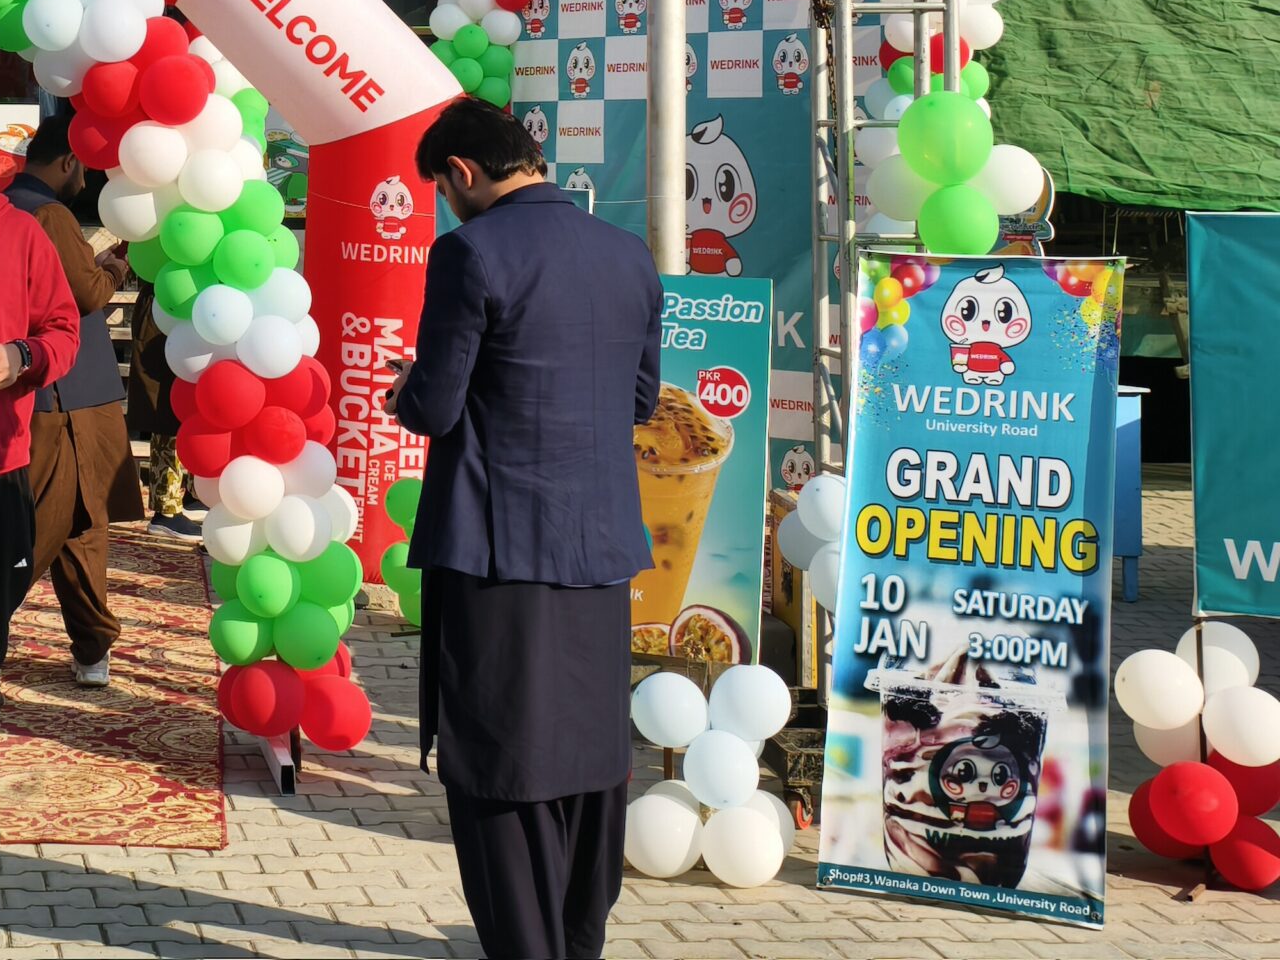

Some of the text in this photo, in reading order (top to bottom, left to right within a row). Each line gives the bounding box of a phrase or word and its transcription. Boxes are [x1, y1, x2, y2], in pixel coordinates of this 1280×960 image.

[560, 1, 604, 12] WEDRINK
[515, 66, 556, 76] WEDRINK
[607, 62, 648, 73] WEDRIN
[710, 58, 760, 70] WEDRINK
[559, 127, 601, 137] WEDRINK
[662, 292, 763, 322] Passion
[661, 322, 707, 350] Tea
[698, 370, 721, 381] PKR
[336, 311, 372, 496] & BUCKET
[700, 382, 748, 407] 400
[770, 398, 814, 413] WEDRIN
[892, 384, 1076, 422] WEDRINK
[925, 418, 1038, 438] University Road
[367, 459, 381, 506] CREAM
[384, 460, 397, 481] ICE
[885, 446, 1073, 509] GRAND
[855, 503, 1099, 573] OPENING
[859, 572, 906, 612] 10
[952, 588, 1089, 625] SATURDAY
[853, 617, 928, 660] JAN
[968, 632, 1069, 668] 3:00PM
[922, 881, 956, 896] Down
[959, 887, 990, 901] Town
[1059, 901, 1091, 916] Road
